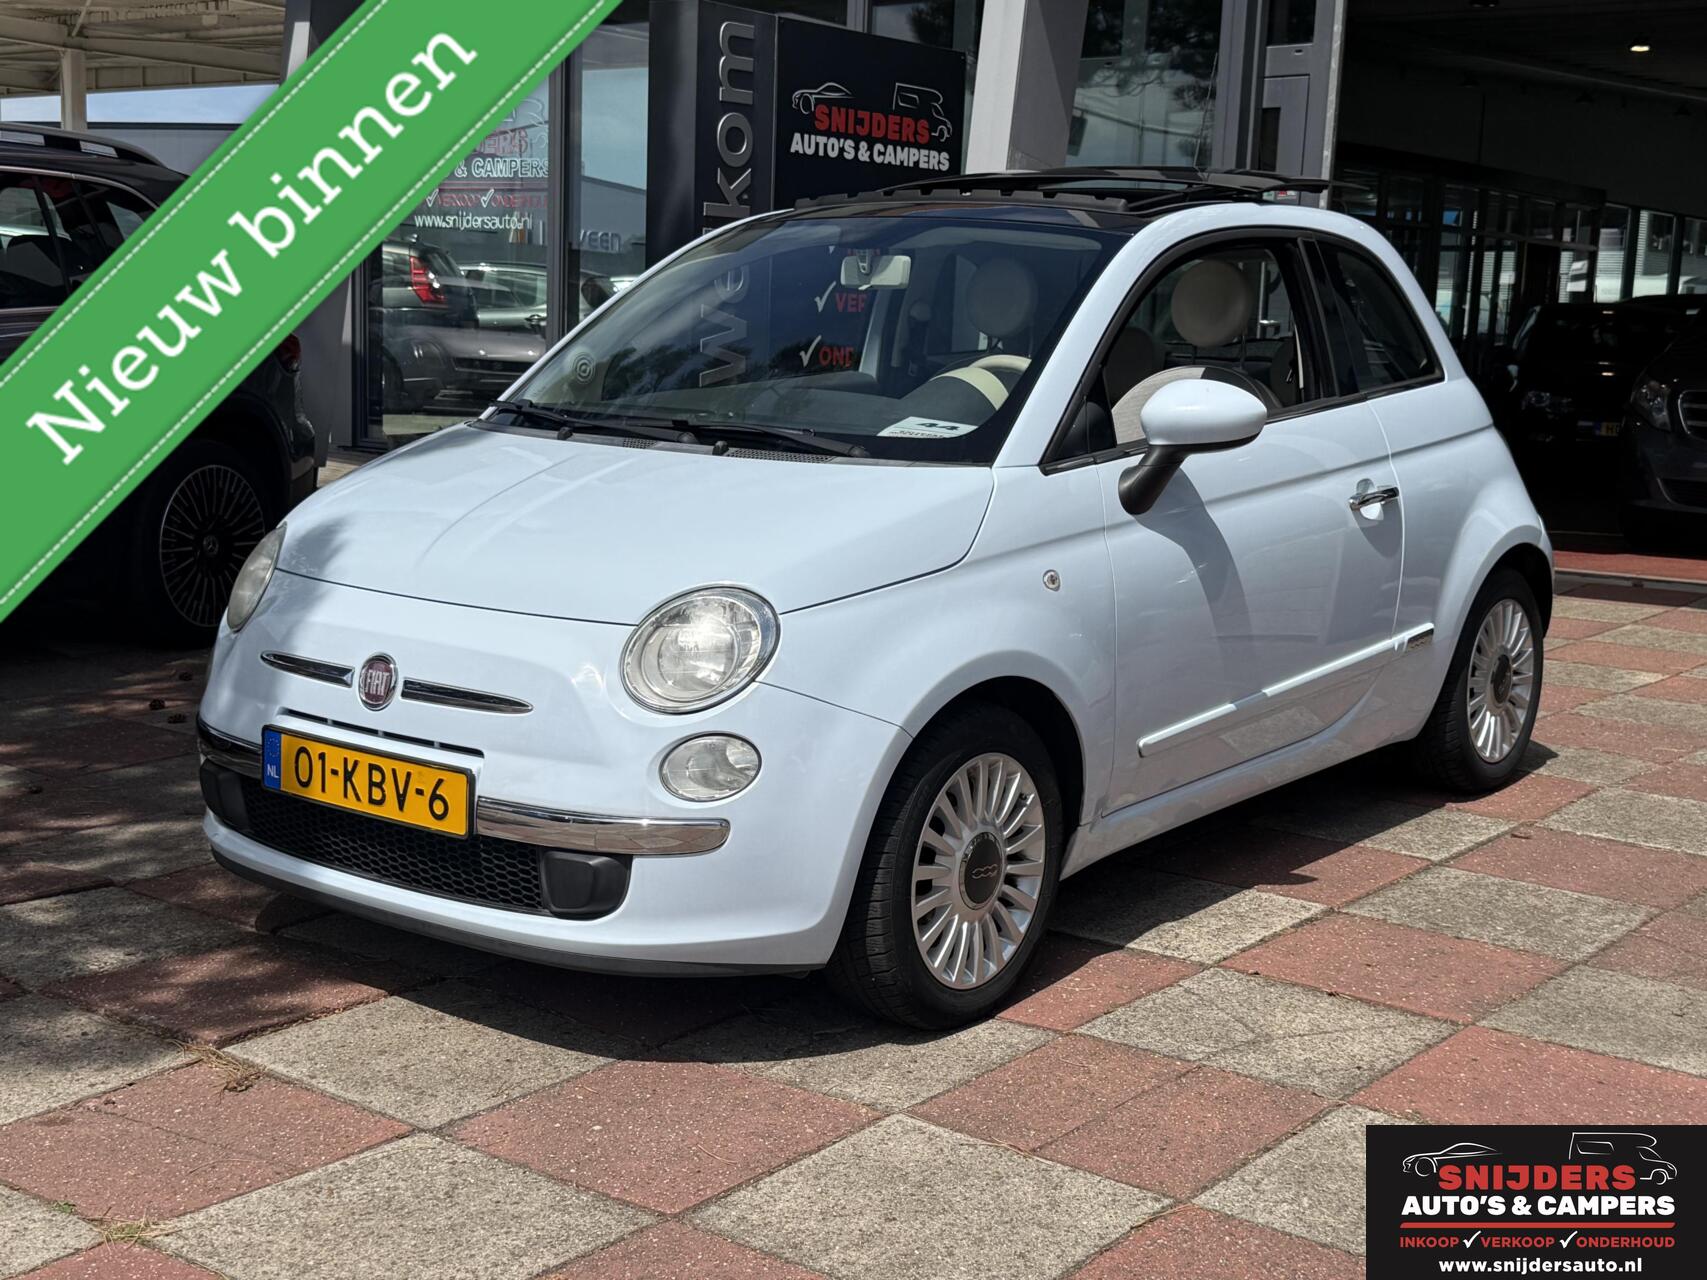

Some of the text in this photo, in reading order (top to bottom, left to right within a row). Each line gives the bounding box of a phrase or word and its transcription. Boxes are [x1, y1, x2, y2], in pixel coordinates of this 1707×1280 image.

[815, 104, 930, 145] SNIJDERS
[472, 157, 550, 178] CAMPERS
[790, 132, 950, 172] AUTO'S & CAMPERS
[699, 21, 755, 388] Wekom
[364, 670, 391, 697] FIAT
[266, 763, 280, 779] NL
[293, 745, 450, 822] 01-KBV-6
